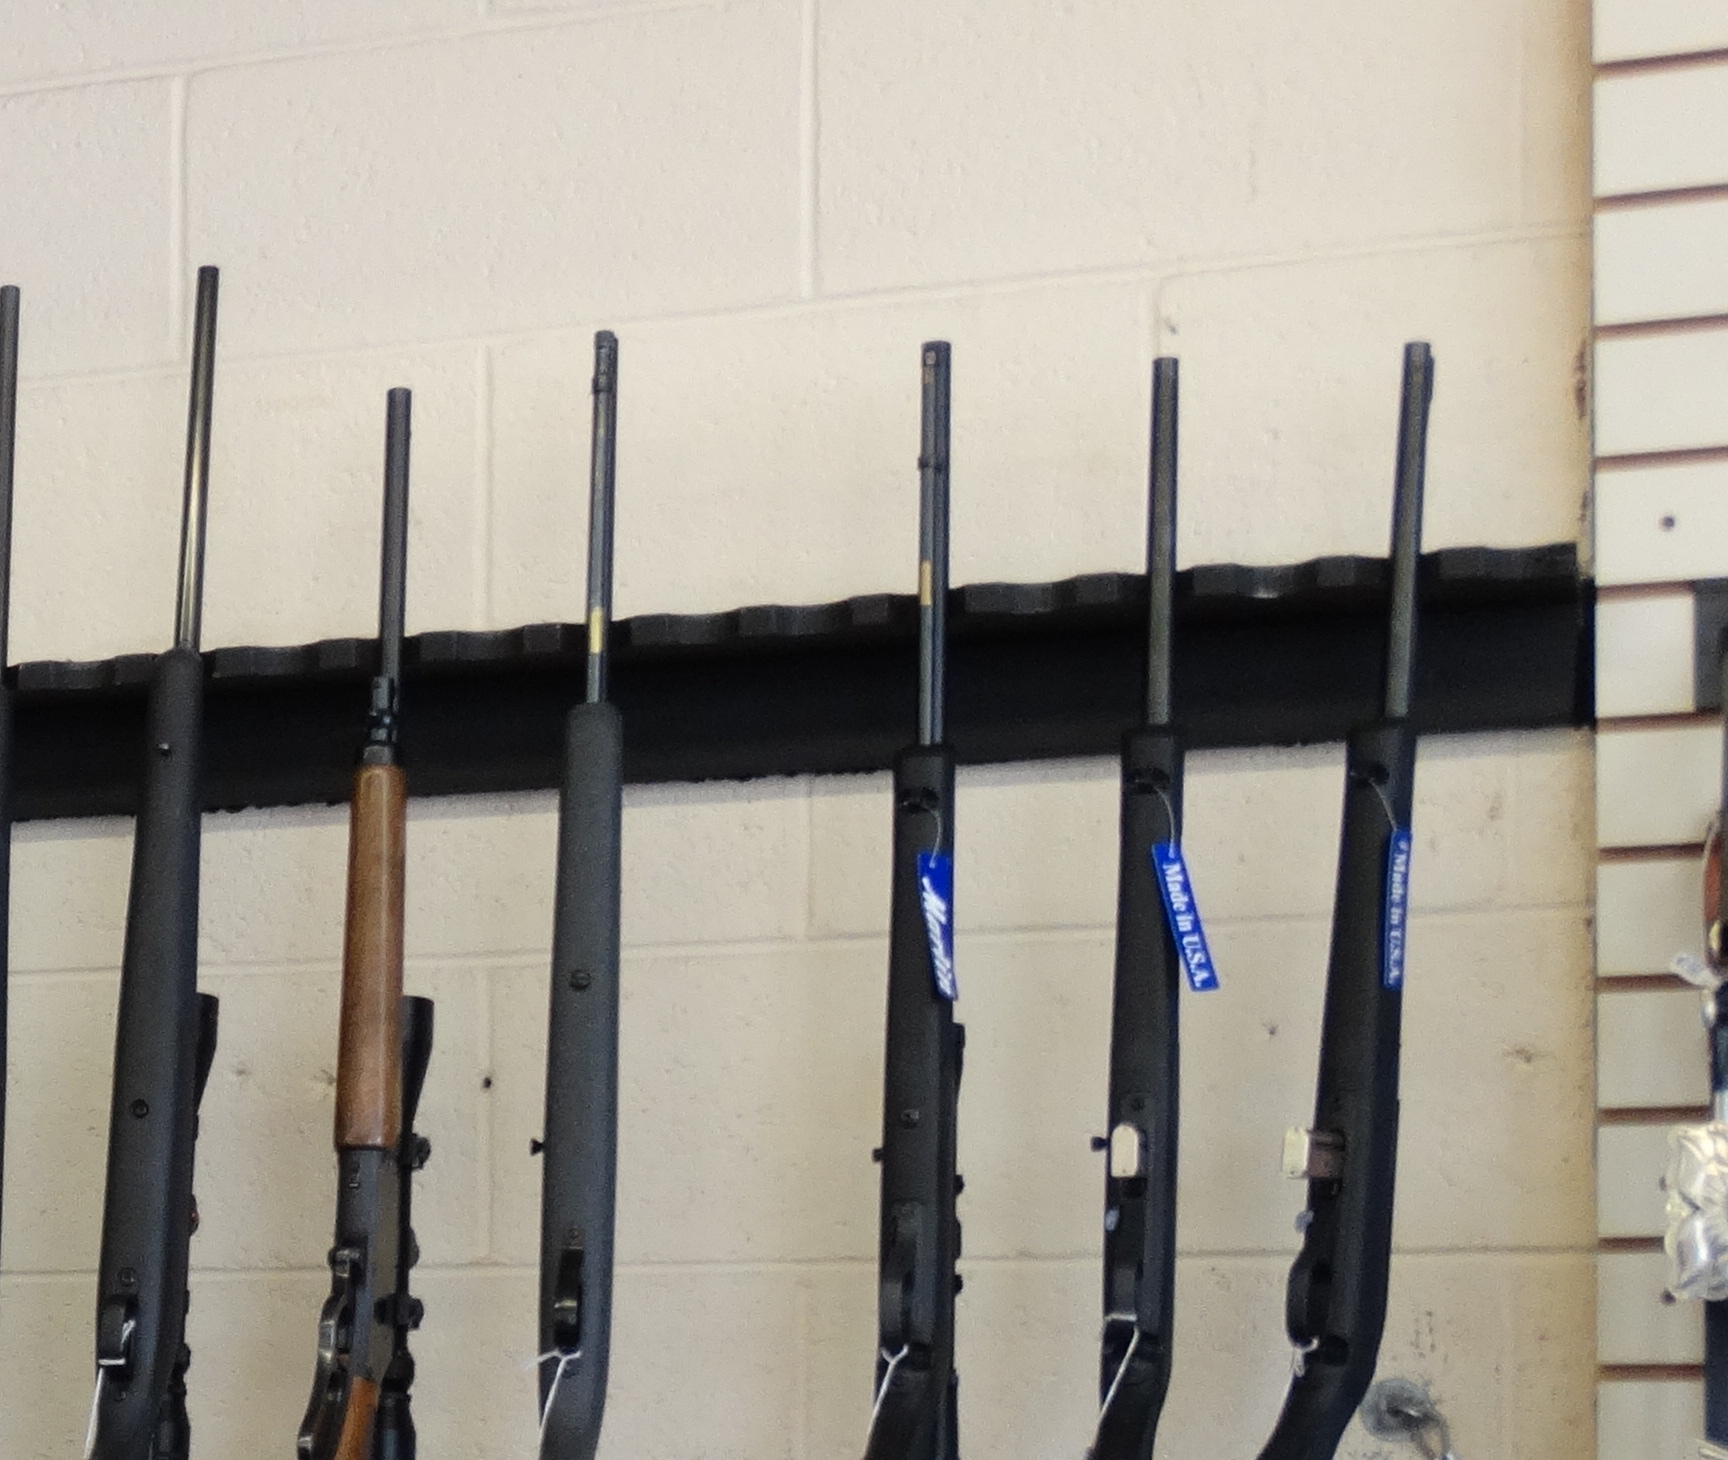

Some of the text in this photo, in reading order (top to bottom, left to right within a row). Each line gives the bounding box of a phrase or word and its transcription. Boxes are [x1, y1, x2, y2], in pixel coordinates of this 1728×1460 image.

[1391, 853, 1407, 903] Made
[1163, 862, 1210, 988] Made in U.S.A.
